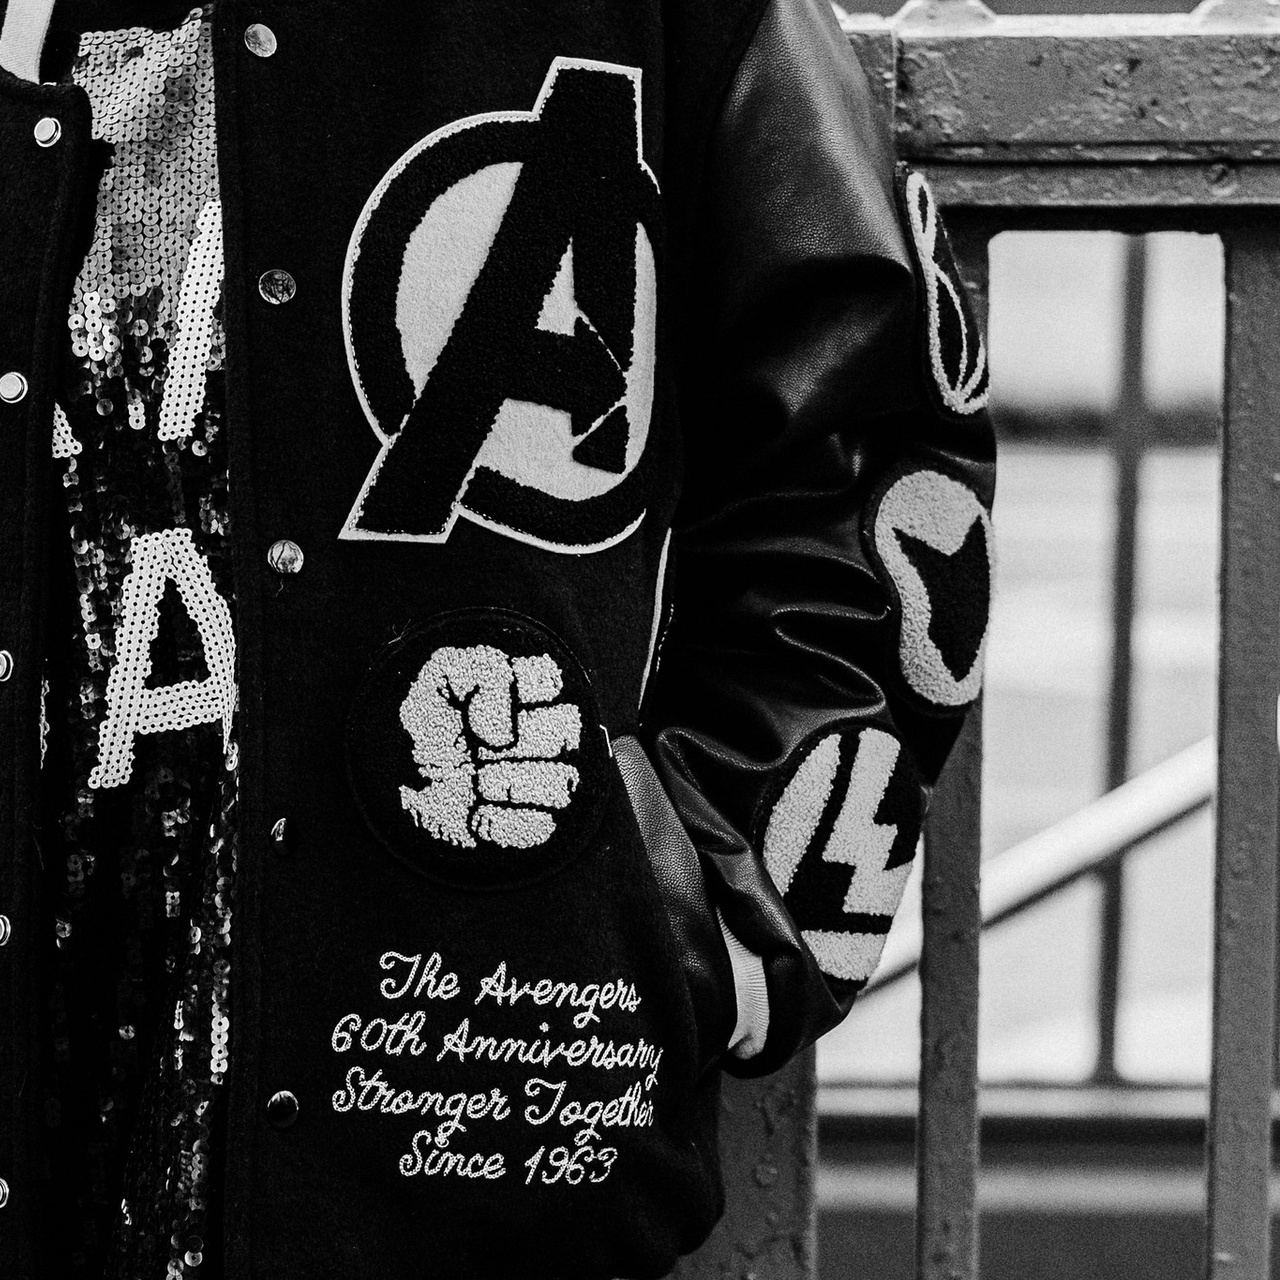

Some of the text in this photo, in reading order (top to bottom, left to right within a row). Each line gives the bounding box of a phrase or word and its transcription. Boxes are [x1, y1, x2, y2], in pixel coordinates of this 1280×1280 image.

[337, 55, 660, 556] A
[379, 950, 642, 1029] The Avengers
[331, 1010, 664, 1091] 60th Anniversary
[331, 1065, 654, 1146] Stronger Together
[398, 1129, 619, 1186] Since 1963
